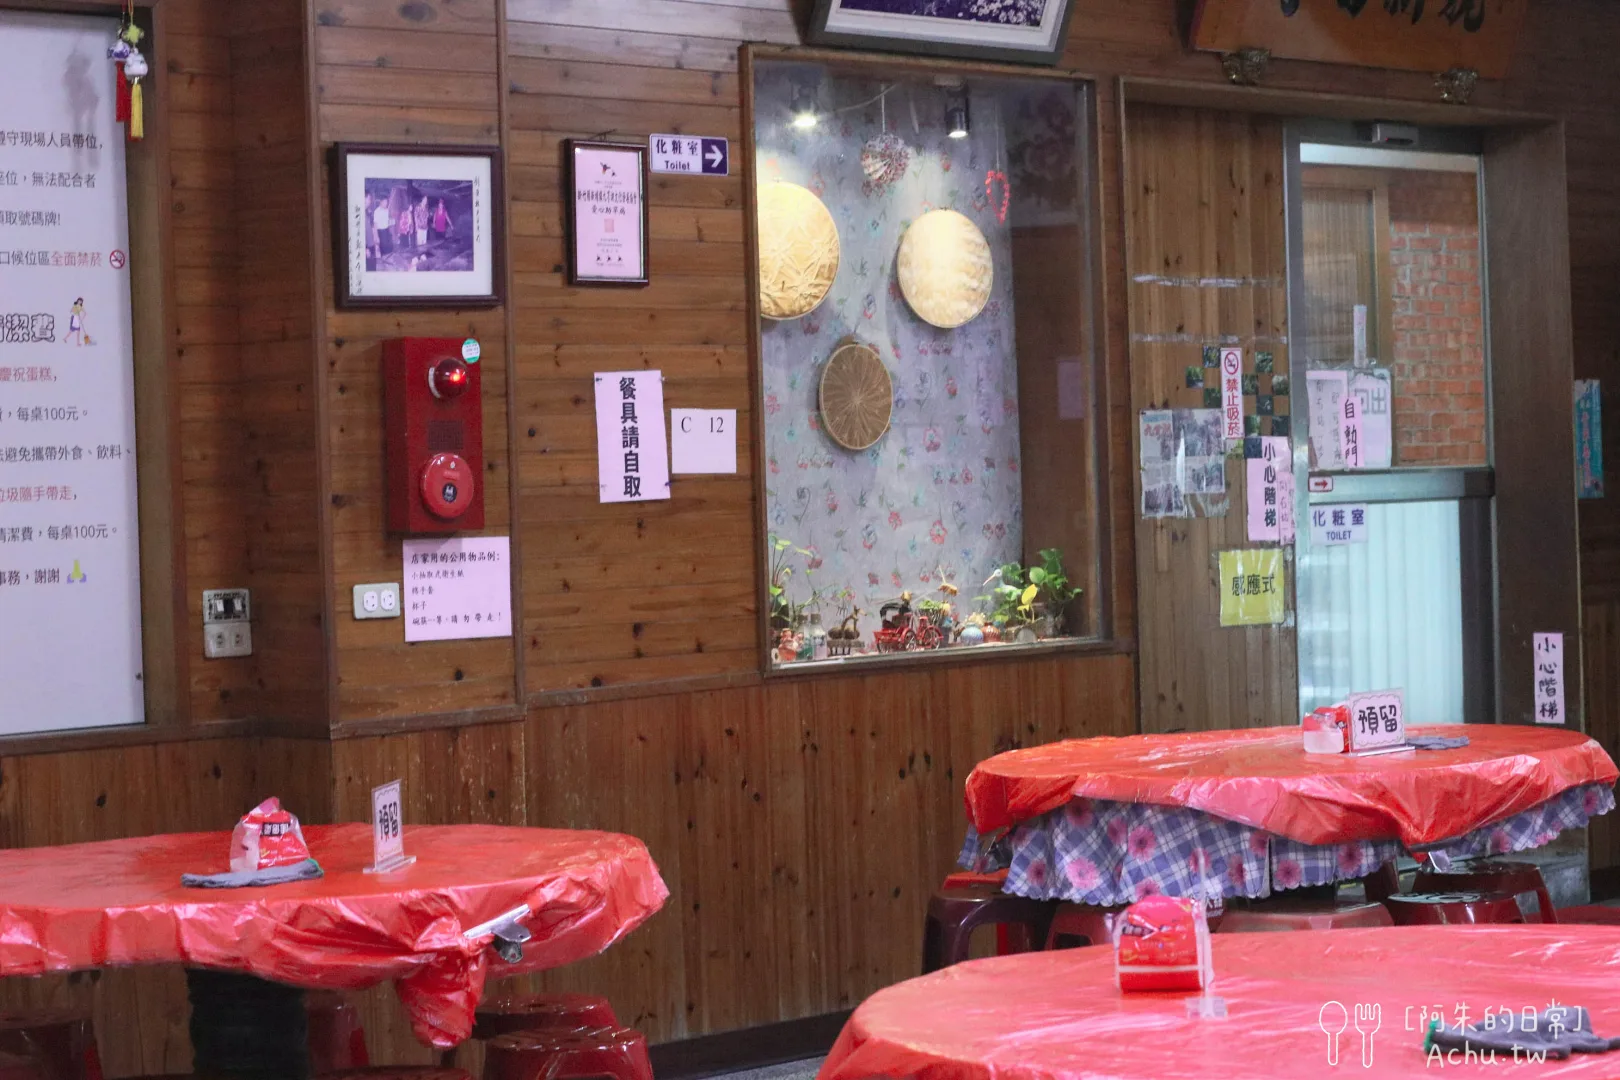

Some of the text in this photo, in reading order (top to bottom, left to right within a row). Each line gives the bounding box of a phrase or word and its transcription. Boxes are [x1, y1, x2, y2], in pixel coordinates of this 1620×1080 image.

[656, 138, 698, 156] 化粧室
[664, 160, 690, 171] Toilet
[0, 312, 55, 343] 潔費
[1226, 378, 1240, 436] 禁止吸菸
[619, 376, 641, 498] 餐具請自取
[681, 416, 724, 433] C 12
[1344, 398, 1358, 467] 自動門
[1263, 442, 1276, 527] 小心階梯
[1313, 508, 1364, 527] 化粧室
[1326, 530, 1351, 541] TOILET
[1232, 573, 1276, 597] 感應式
[1538, 636, 1558, 720] 小心階梯
[1358, 704, 1398, 735] 預留
